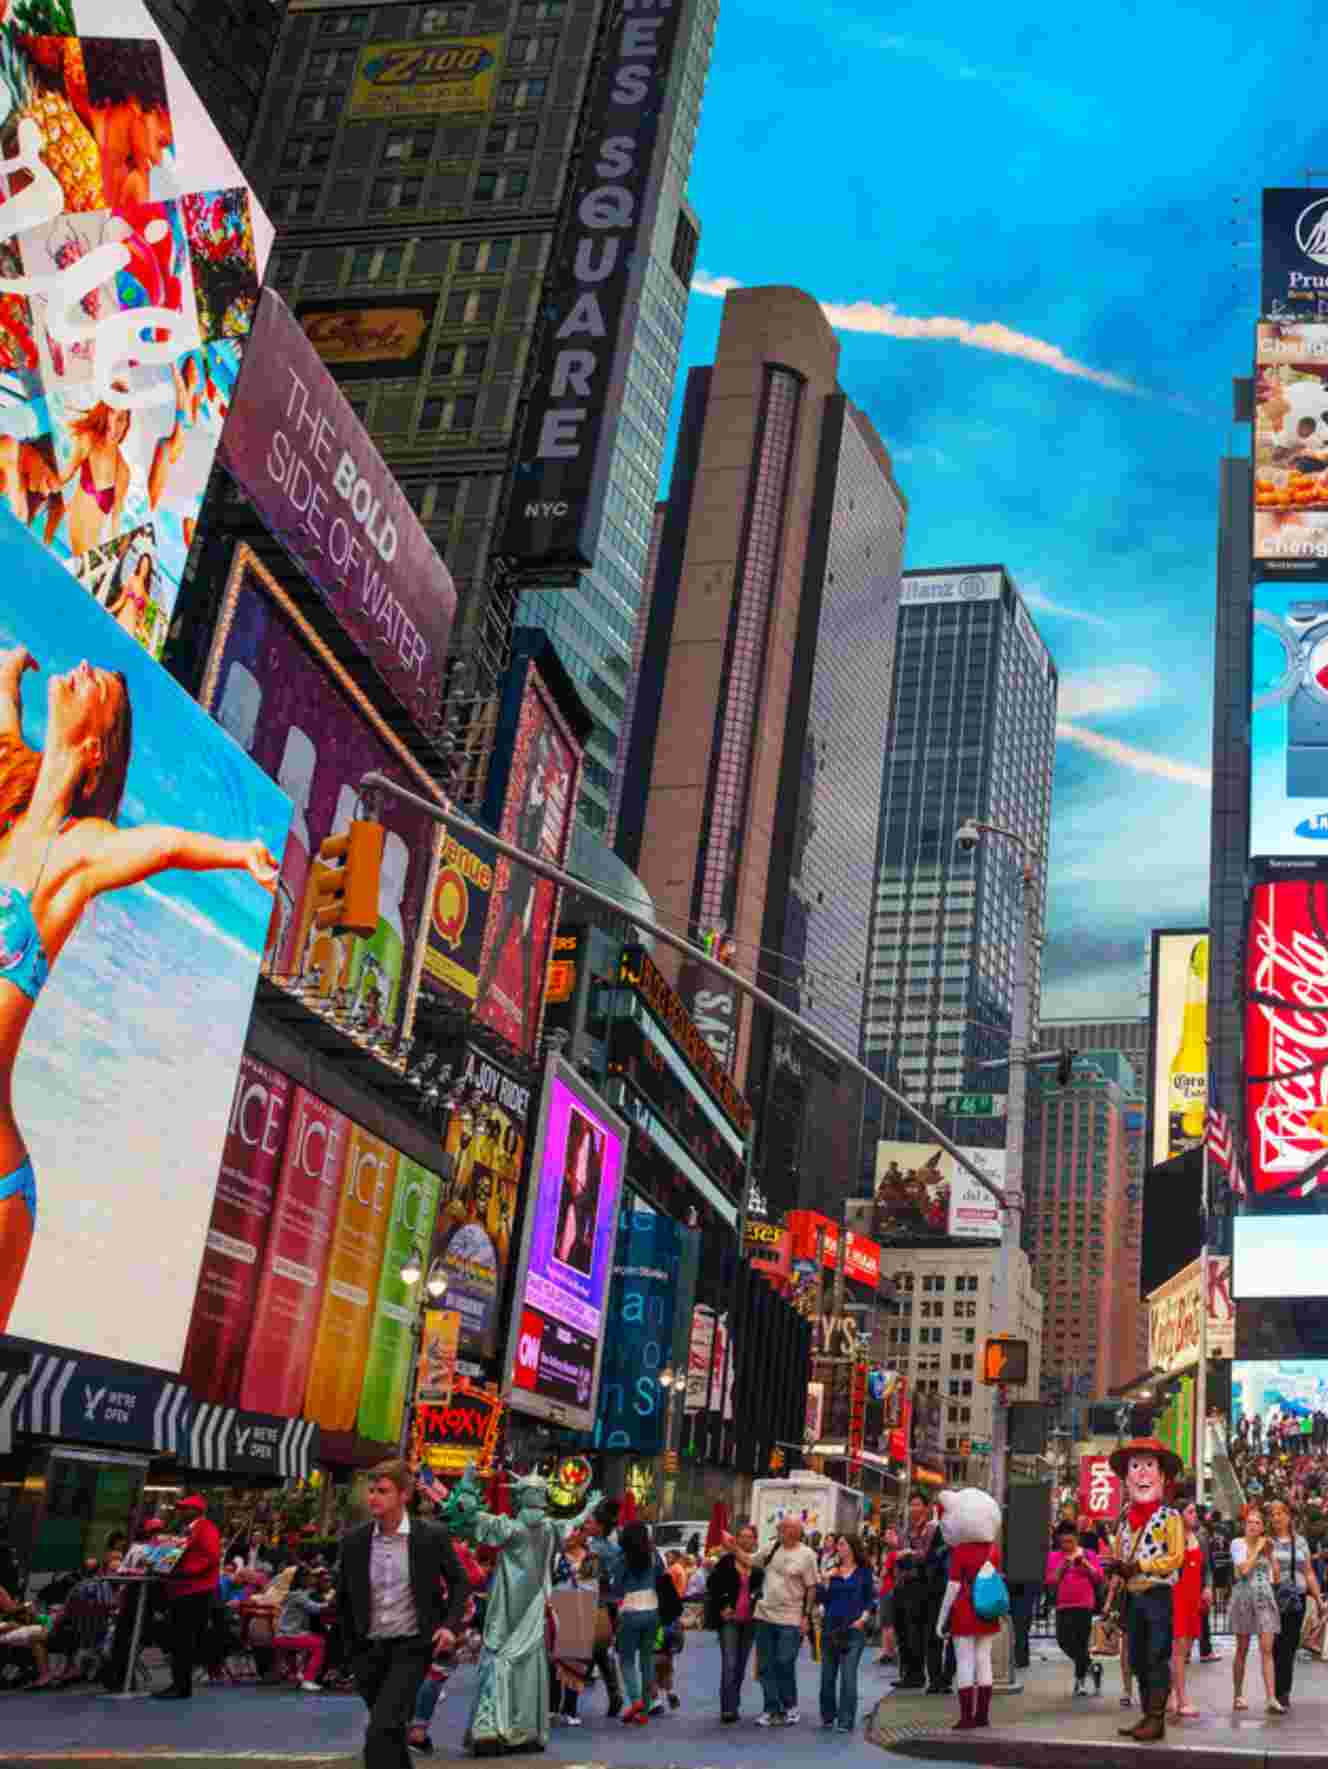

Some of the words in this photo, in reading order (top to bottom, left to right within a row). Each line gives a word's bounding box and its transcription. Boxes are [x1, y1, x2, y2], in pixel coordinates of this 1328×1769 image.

[537, 136, 636, 459] SQUARE
[286, 366, 337, 475] THE
[332, 450, 398, 564] BOLD
[525, 502, 568, 517] NYC
[266, 430, 329, 543] SIDE
[328, 517, 363, 572] OF
[360, 558, 427, 682] WATER
[432, 866, 469, 950] Q
[227, 1073, 285, 1156] ICE
[293, 1114, 337, 1187] ICE
[104, 1407, 129, 1423] OPEN
